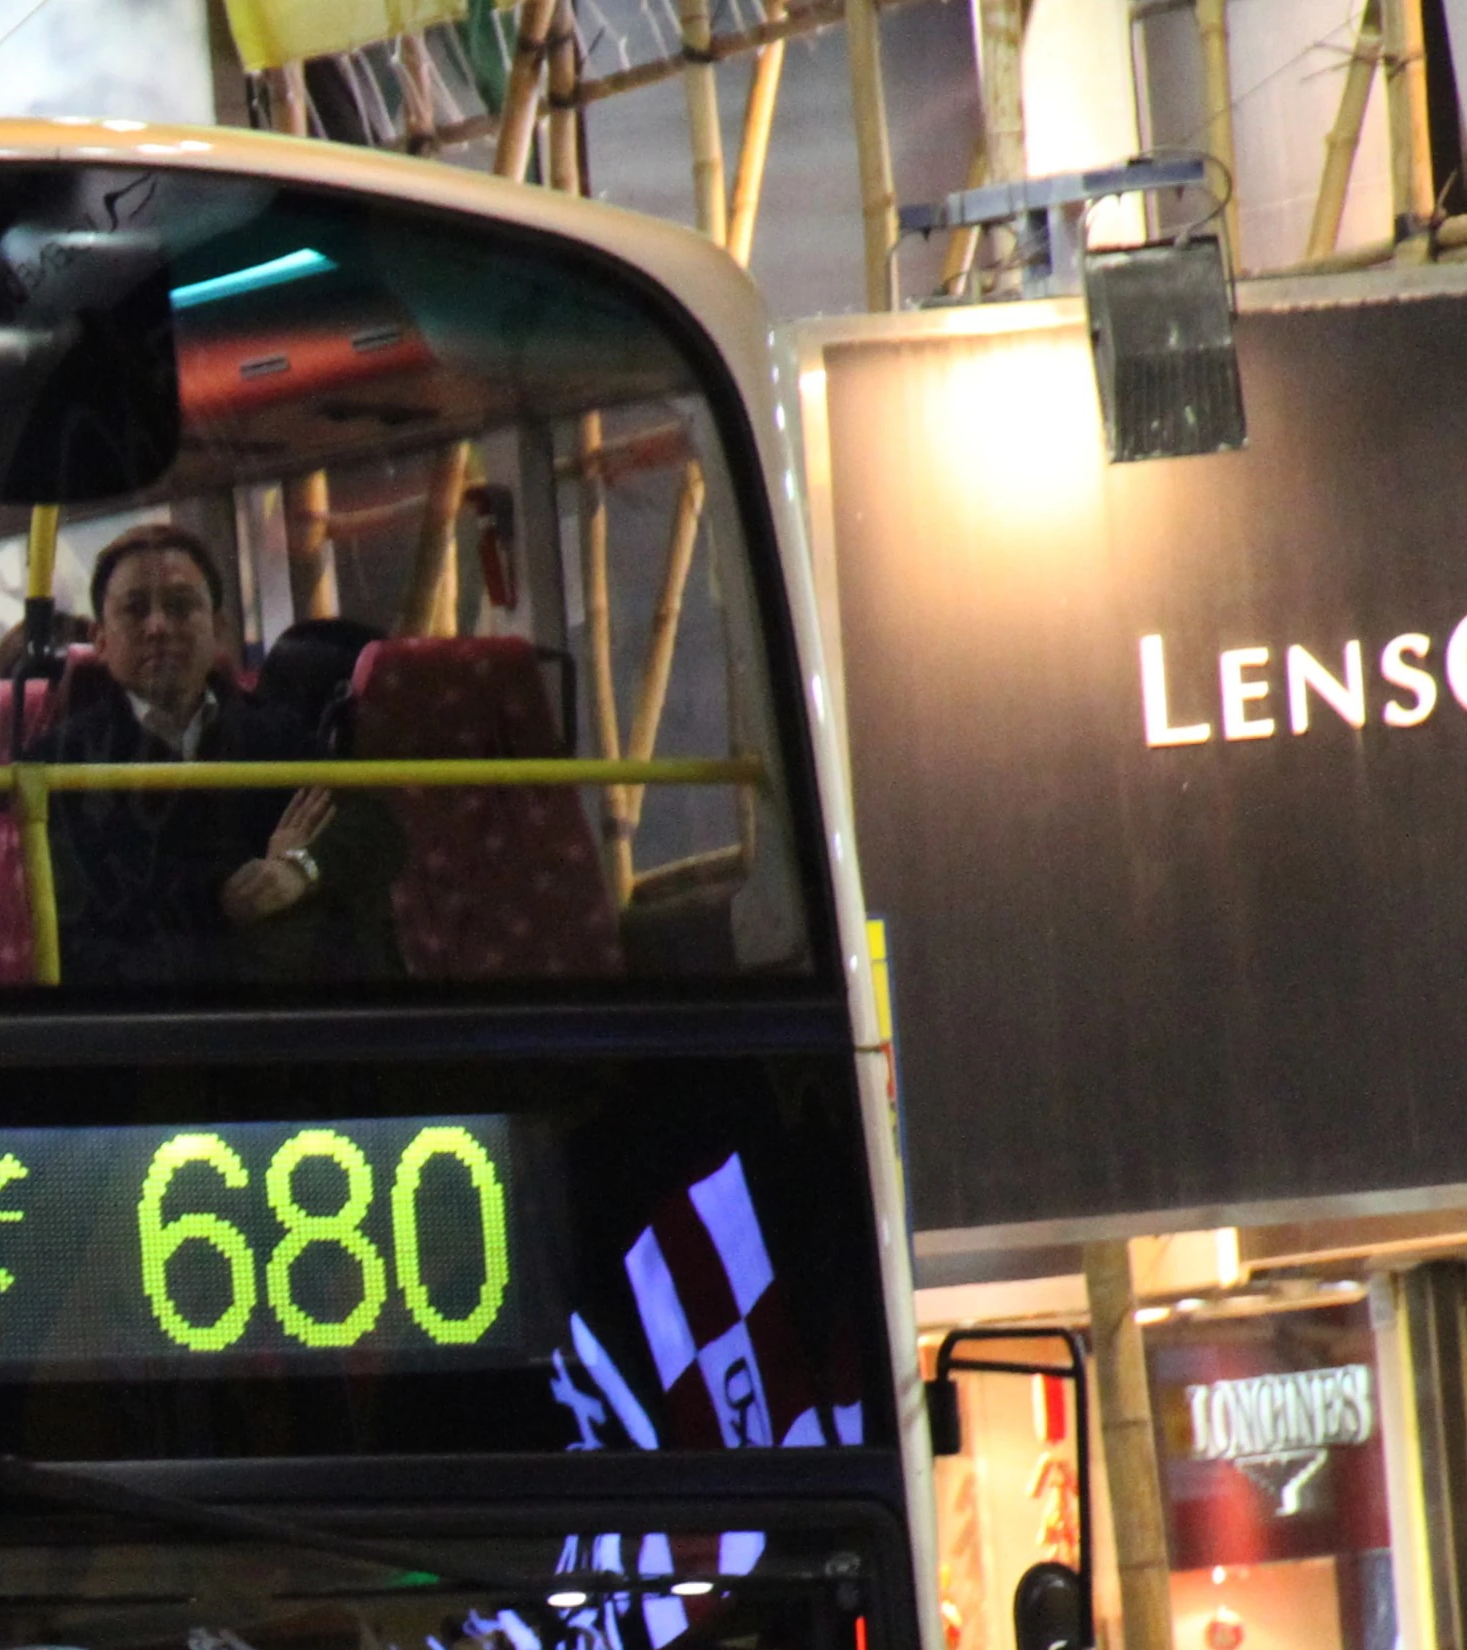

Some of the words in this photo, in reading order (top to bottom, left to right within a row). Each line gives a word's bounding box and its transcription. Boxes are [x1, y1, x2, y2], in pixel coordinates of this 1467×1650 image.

[1140, 612, 1467, 748] LENS
[138, 1126, 510, 1352] 680
[1186, 1363, 1370, 1460] LONGINES
